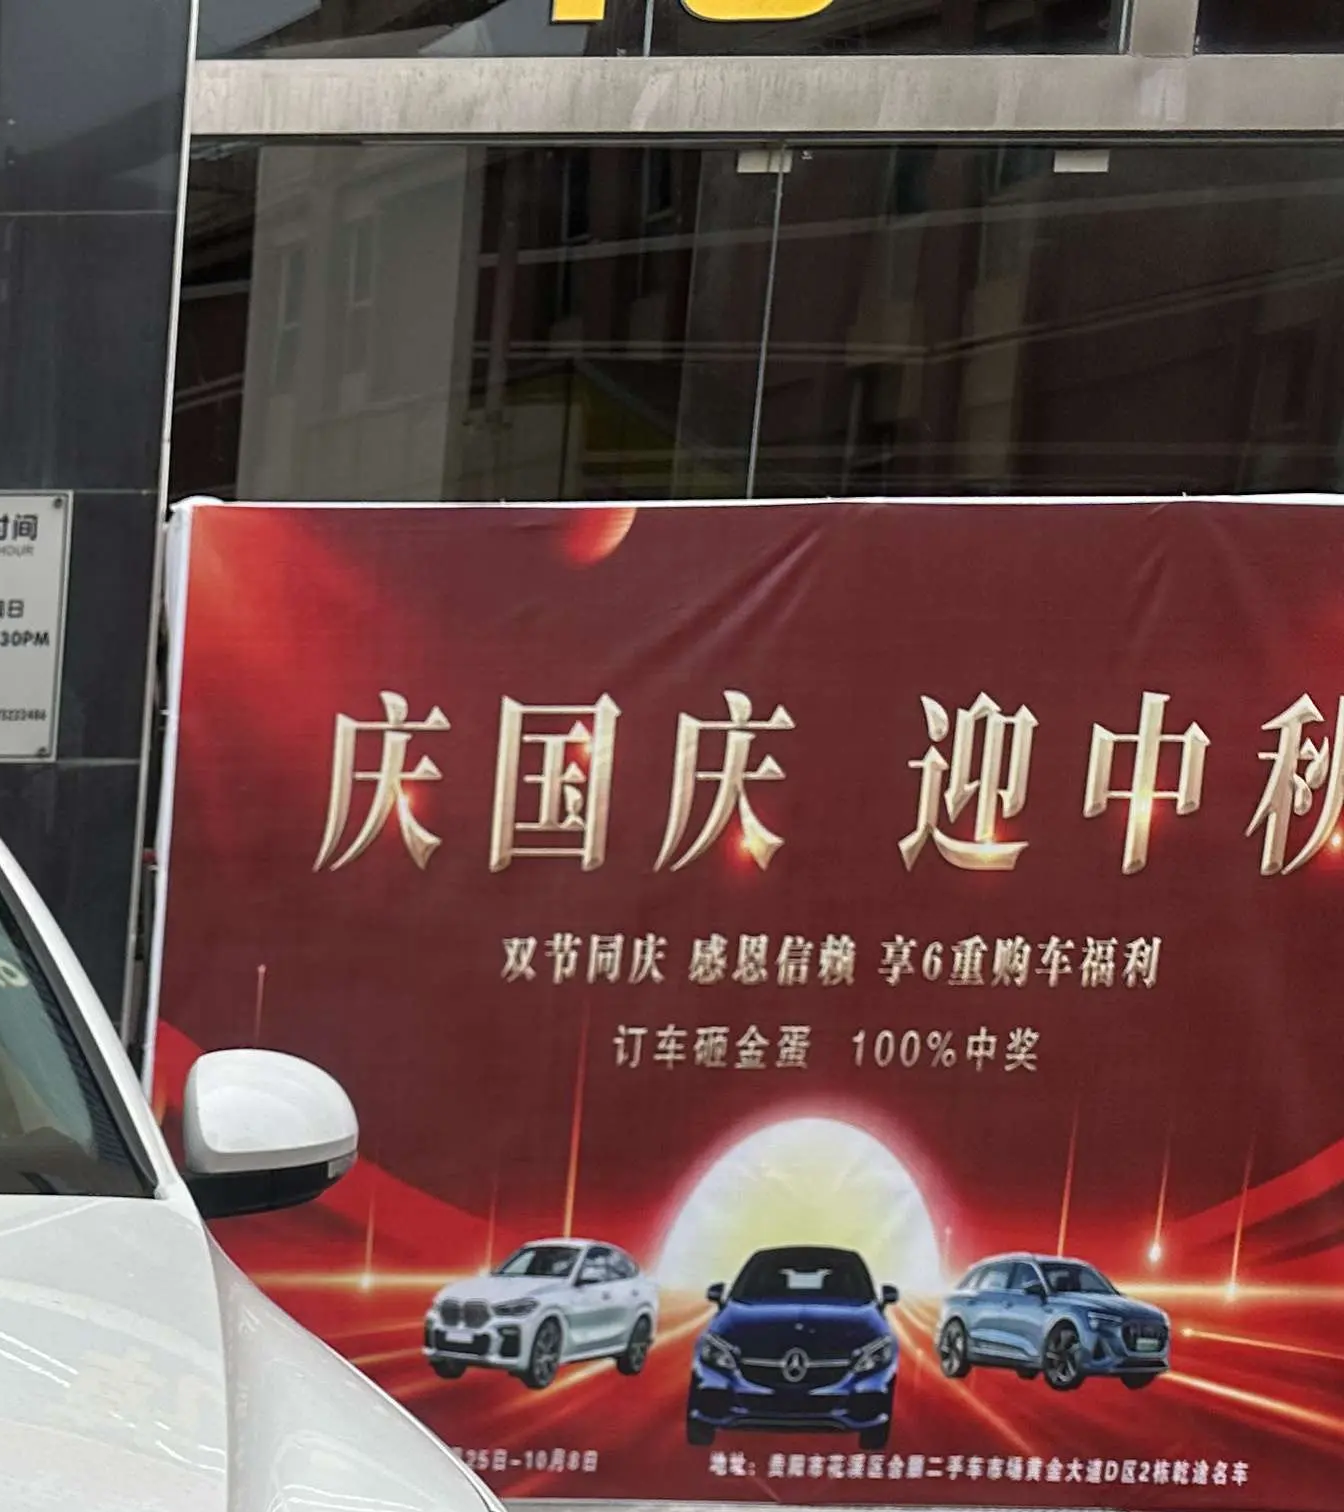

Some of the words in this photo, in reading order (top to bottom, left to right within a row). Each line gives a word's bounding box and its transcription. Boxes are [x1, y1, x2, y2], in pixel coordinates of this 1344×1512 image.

[313, 689, 796, 872] 庆国庆
[898, 690, 1344, 877] 迎中秋
[501, 933, 668, 985] 双节同庆
[688, 933, 857, 987] 感恩信赖
[877, 933, 1162, 989] 享6重购车福利
[611, 1024, 812, 1070] 订车砸金蛋
[851, 1024, 1040, 1071] 100%中奖
